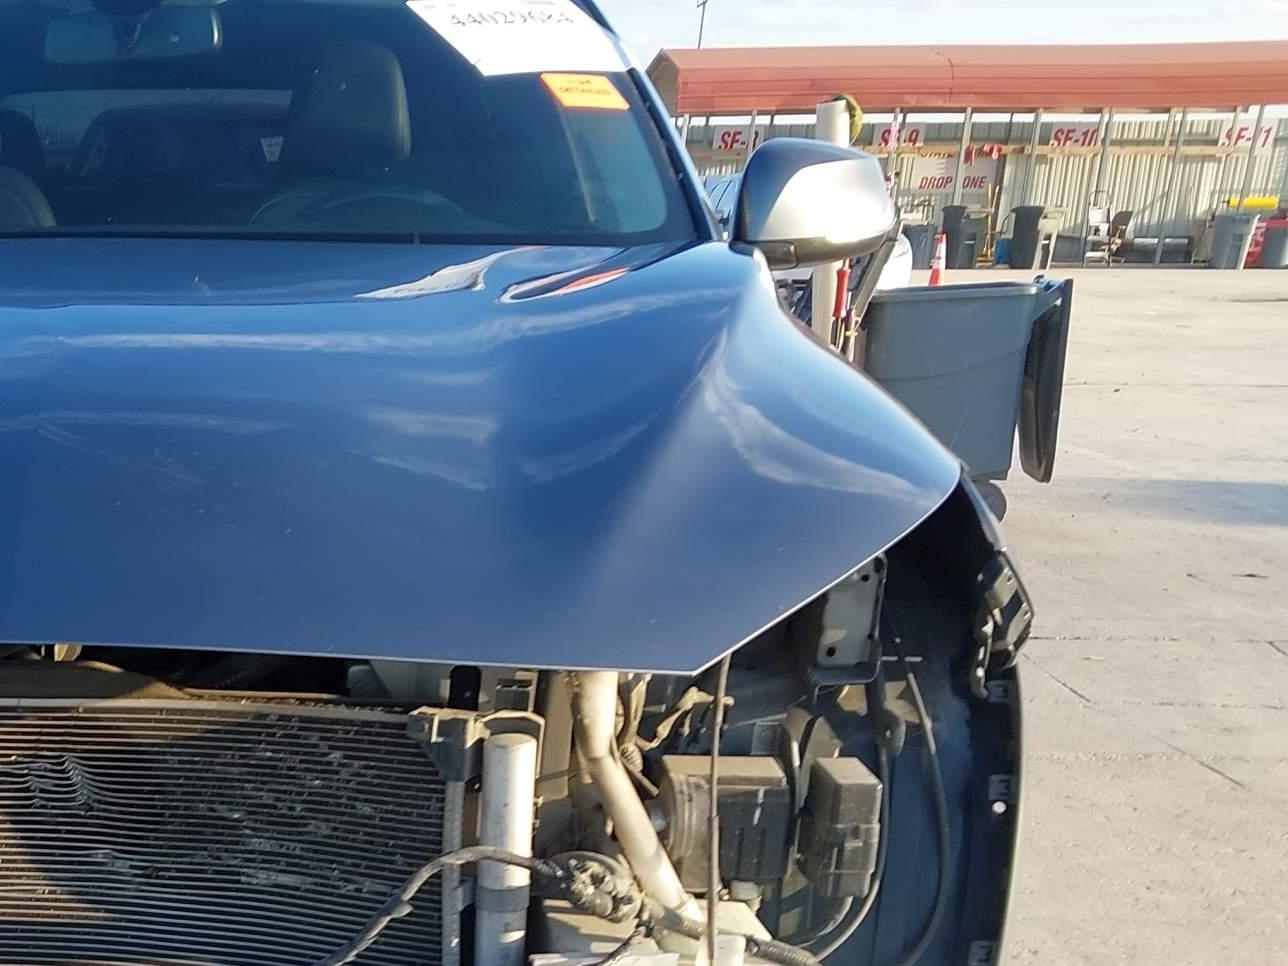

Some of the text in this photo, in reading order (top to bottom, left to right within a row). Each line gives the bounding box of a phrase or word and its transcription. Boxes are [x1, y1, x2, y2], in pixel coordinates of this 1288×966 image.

[878, 128, 920, 146] S-9
[1222, 126, 1273, 148] SF-1
[919, 176, 988, 189] DROP ONE
